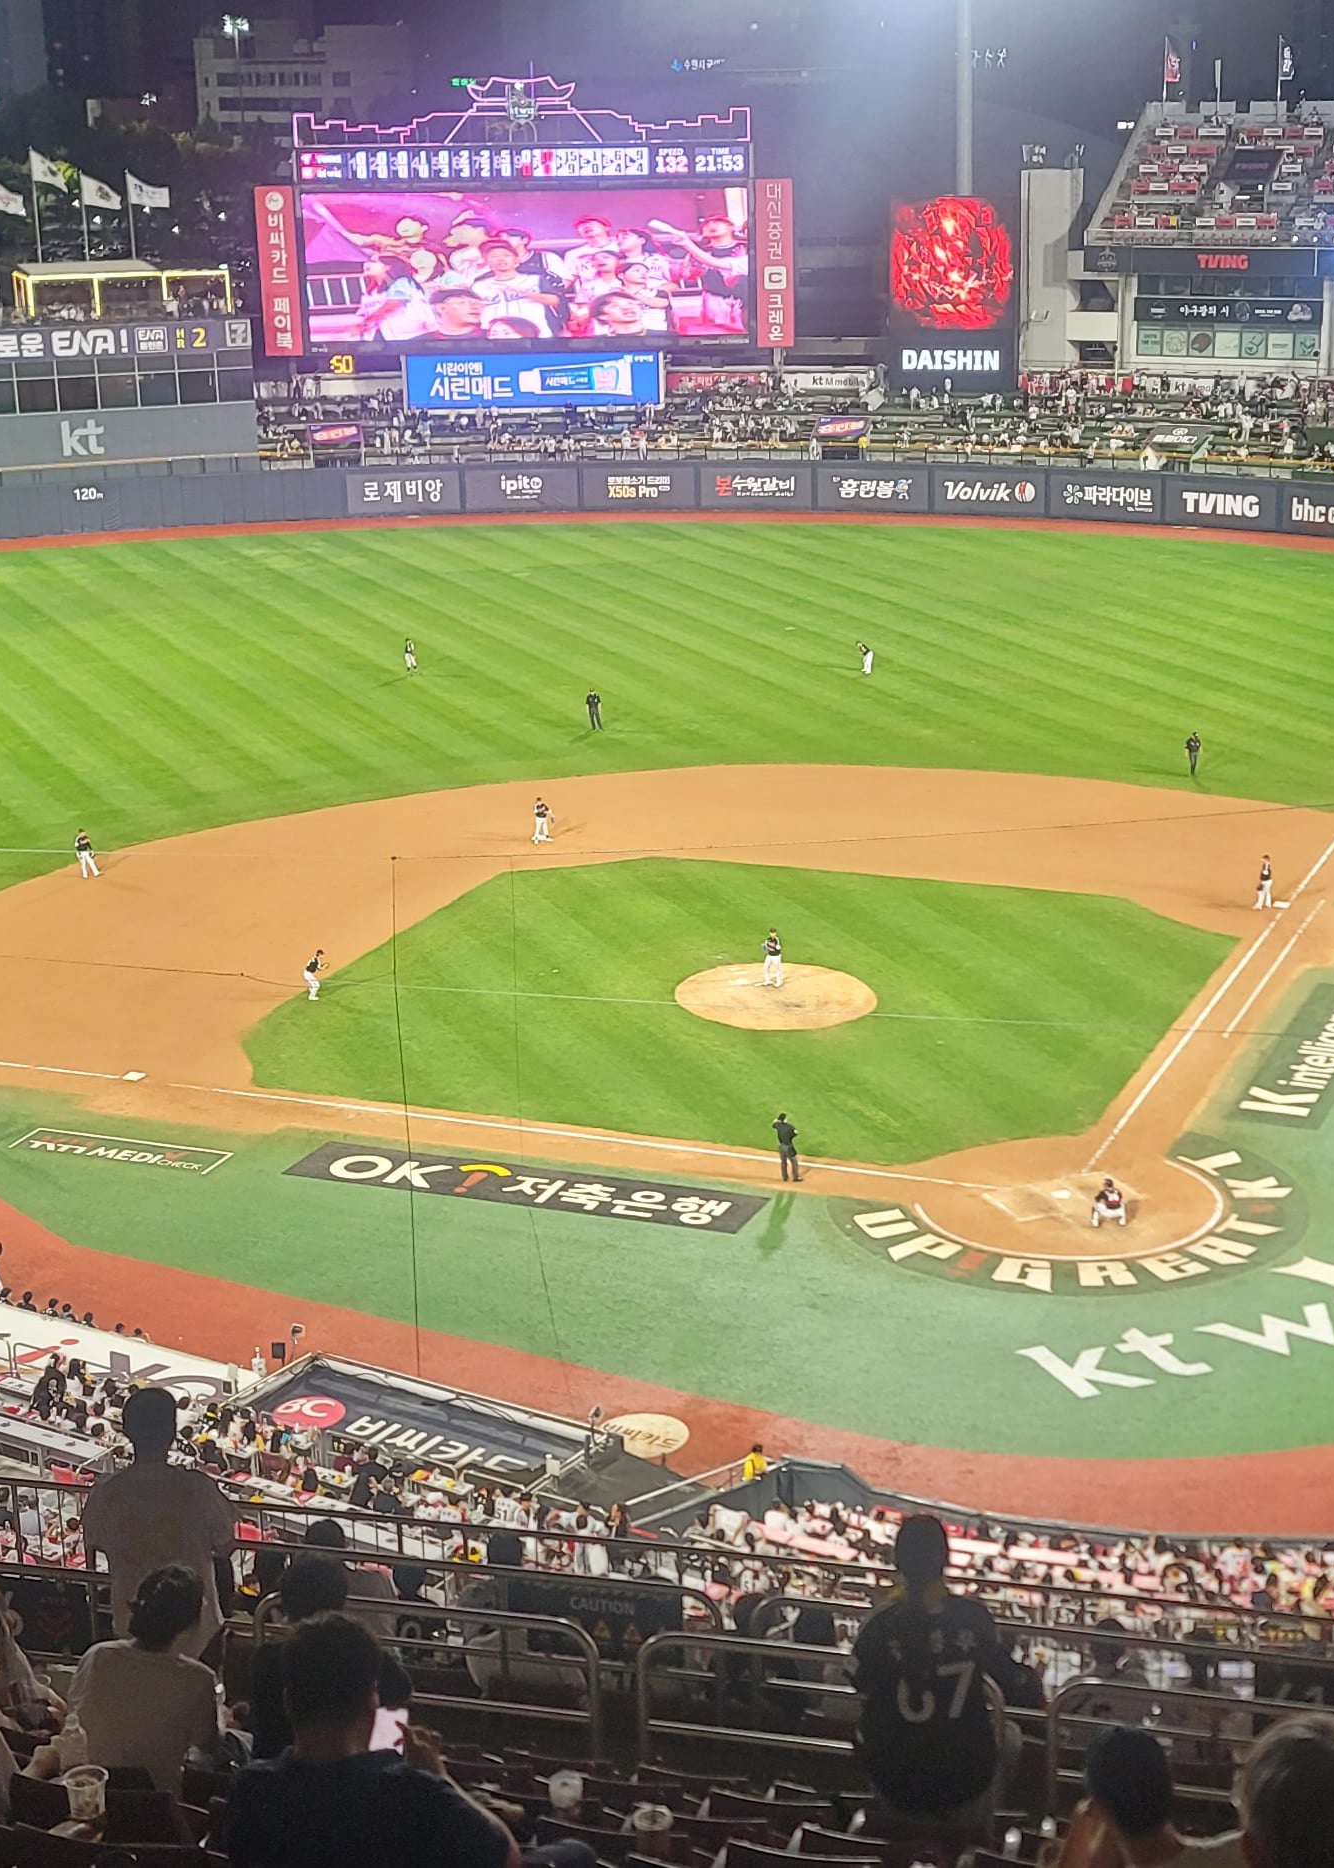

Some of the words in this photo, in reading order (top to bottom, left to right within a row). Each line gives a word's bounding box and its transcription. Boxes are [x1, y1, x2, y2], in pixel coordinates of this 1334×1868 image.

[658, 148, 684, 156] SPEED
[710, 147, 730, 155] TIME
[655, 155, 689, 173] 132
[694, 155, 745, 173] 21:53
[766, 183, 783, 260] 대신증권
[267, 212, 290, 284] 비씨카드
[1197, 253, 1250, 271] TVING
[273, 296, 294, 350] 페이북
[768, 294, 784, 341] 크레온
[191, 327, 207, 348] 2
[901, 347, 1001, 374] DAISHIN
[430, 376, 514, 401] 시린메드
[812, 375, 824, 387] kt
[1174, 378, 1186, 393] kt
[60, 419, 106, 458] kt
[362, 479, 444, 503] 로제비앙
[608, 485, 637, 498] X50s
[638, 485, 659, 498] Pro
[943, 480, 1012, 502] Volvik
[1182, 491, 1260, 518] TVING
[1291, 496, 1326, 523] bhc
[157, 1158, 204, 1171] CHECK
[502, 1175, 732, 1226] 저축은행
[1013, 1327, 1213, 1400] kt
[569, 1595, 636, 1617] CAUTION
